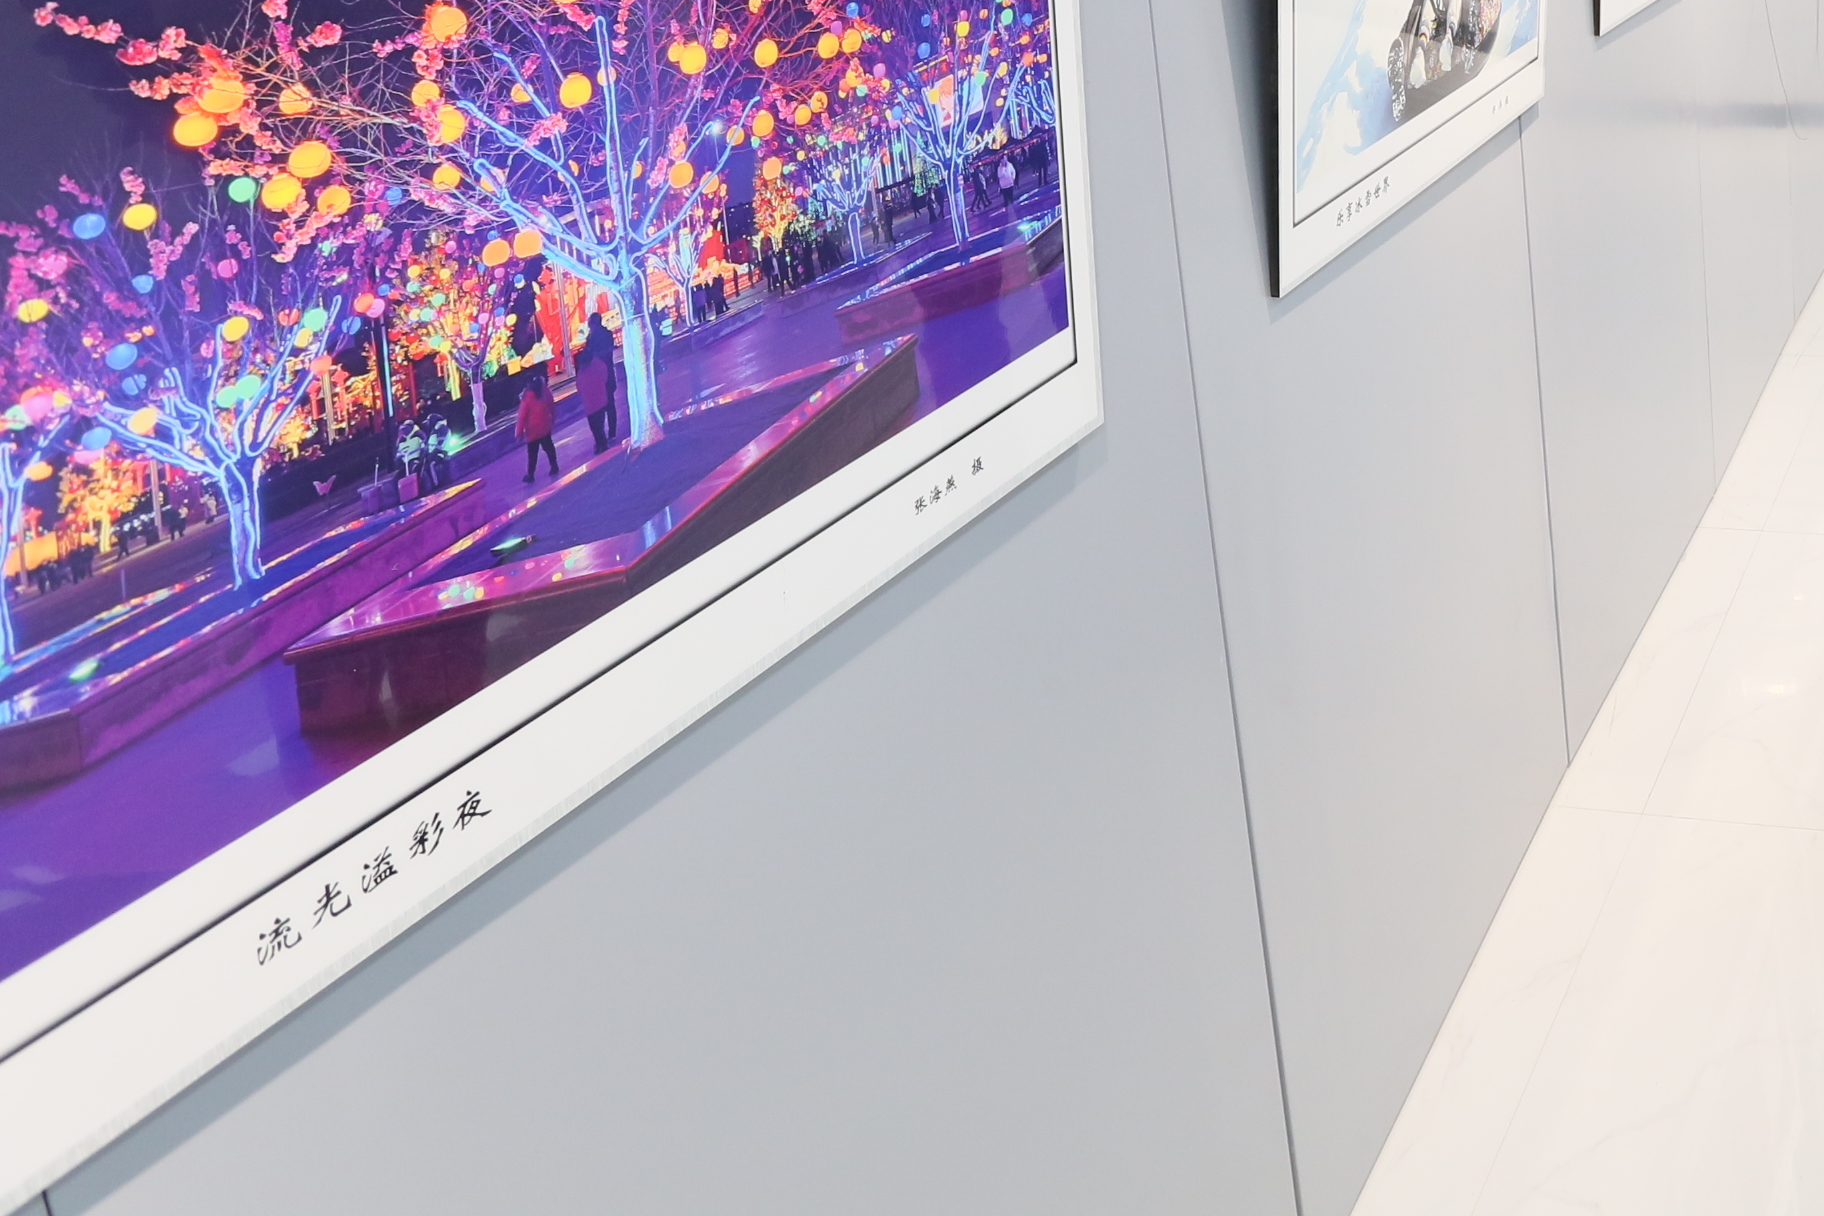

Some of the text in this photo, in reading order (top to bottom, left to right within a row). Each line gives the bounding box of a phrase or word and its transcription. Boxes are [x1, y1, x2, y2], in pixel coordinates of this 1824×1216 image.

[1336, 175, 1390, 227] 乐享冰雪世界
[914, 456, 984, 516] 张海燕 摄
[256, 790, 493, 967] 流光溢彩夜
